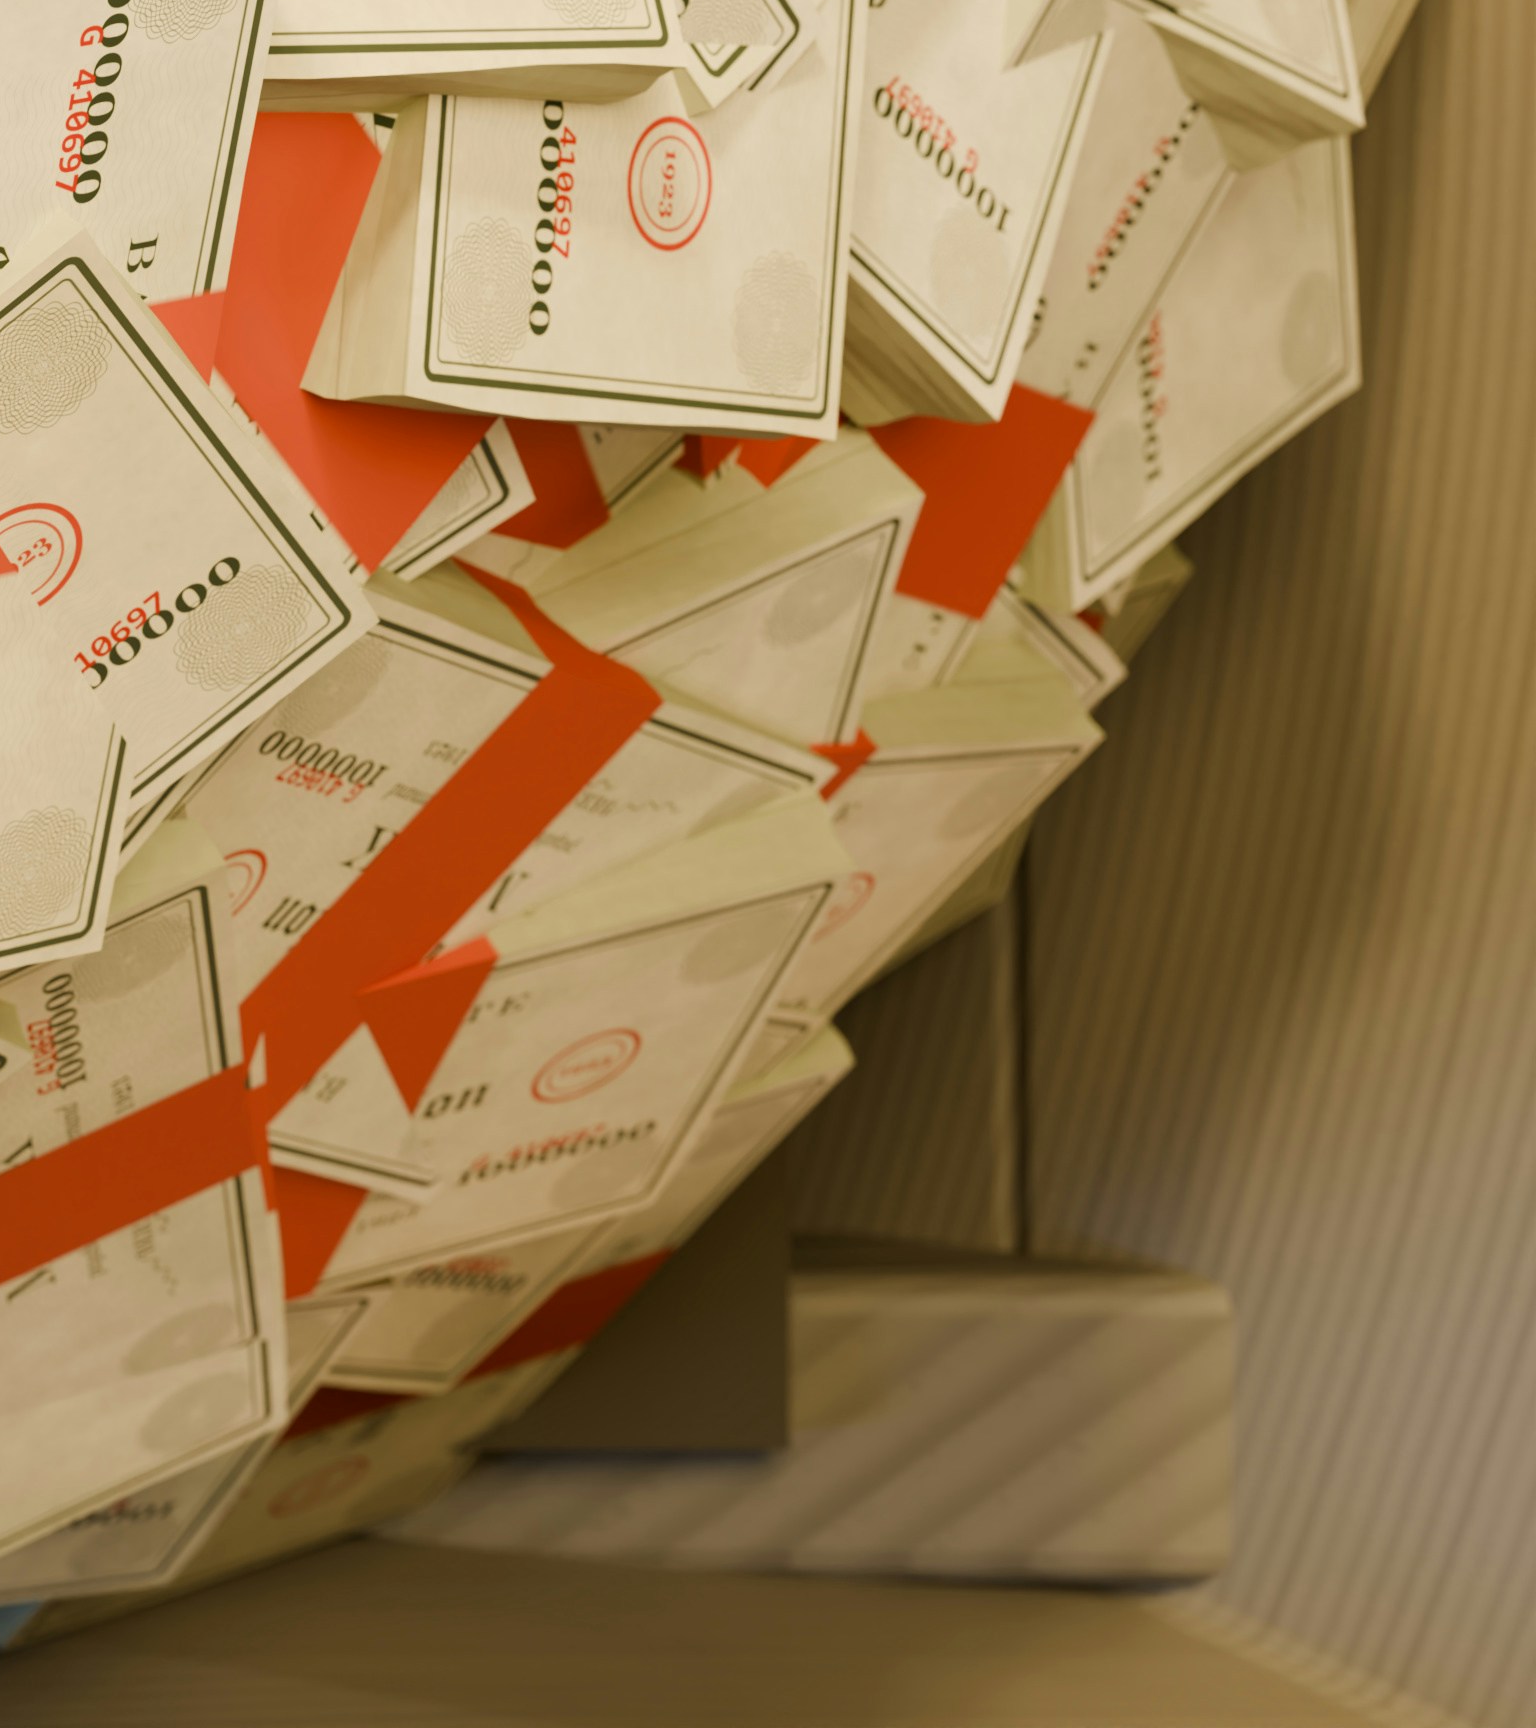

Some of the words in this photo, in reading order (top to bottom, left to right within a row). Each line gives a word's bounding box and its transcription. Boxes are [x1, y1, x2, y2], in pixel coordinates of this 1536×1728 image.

[78, 24, 106, 48] G
[54, 68, 98, 194] 410697
[550, 126, 578, 259] 410697
[658, 151, 678, 219] 1923
[872, 85, 1010, 232] 1000000
